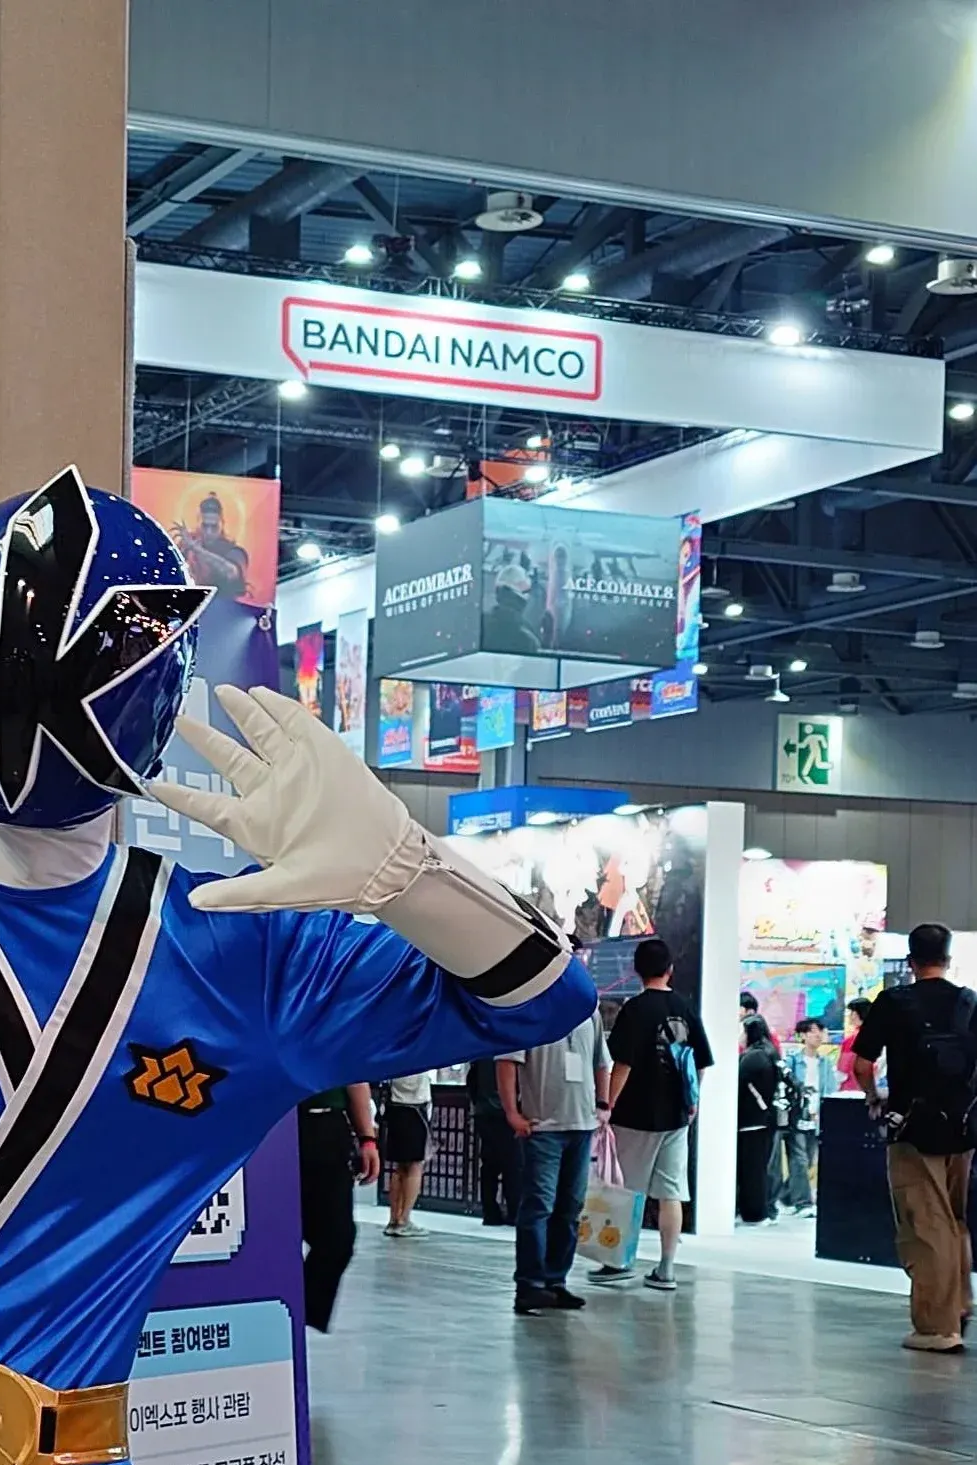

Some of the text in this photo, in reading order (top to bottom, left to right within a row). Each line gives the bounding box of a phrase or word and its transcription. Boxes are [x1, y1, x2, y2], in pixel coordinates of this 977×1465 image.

[302, 318, 585, 380] BANDAI NAMCO
[171, 1322, 230, 1354] 참여방법
[129, 1391, 250, 1432] 이엑스포 행사 관람
